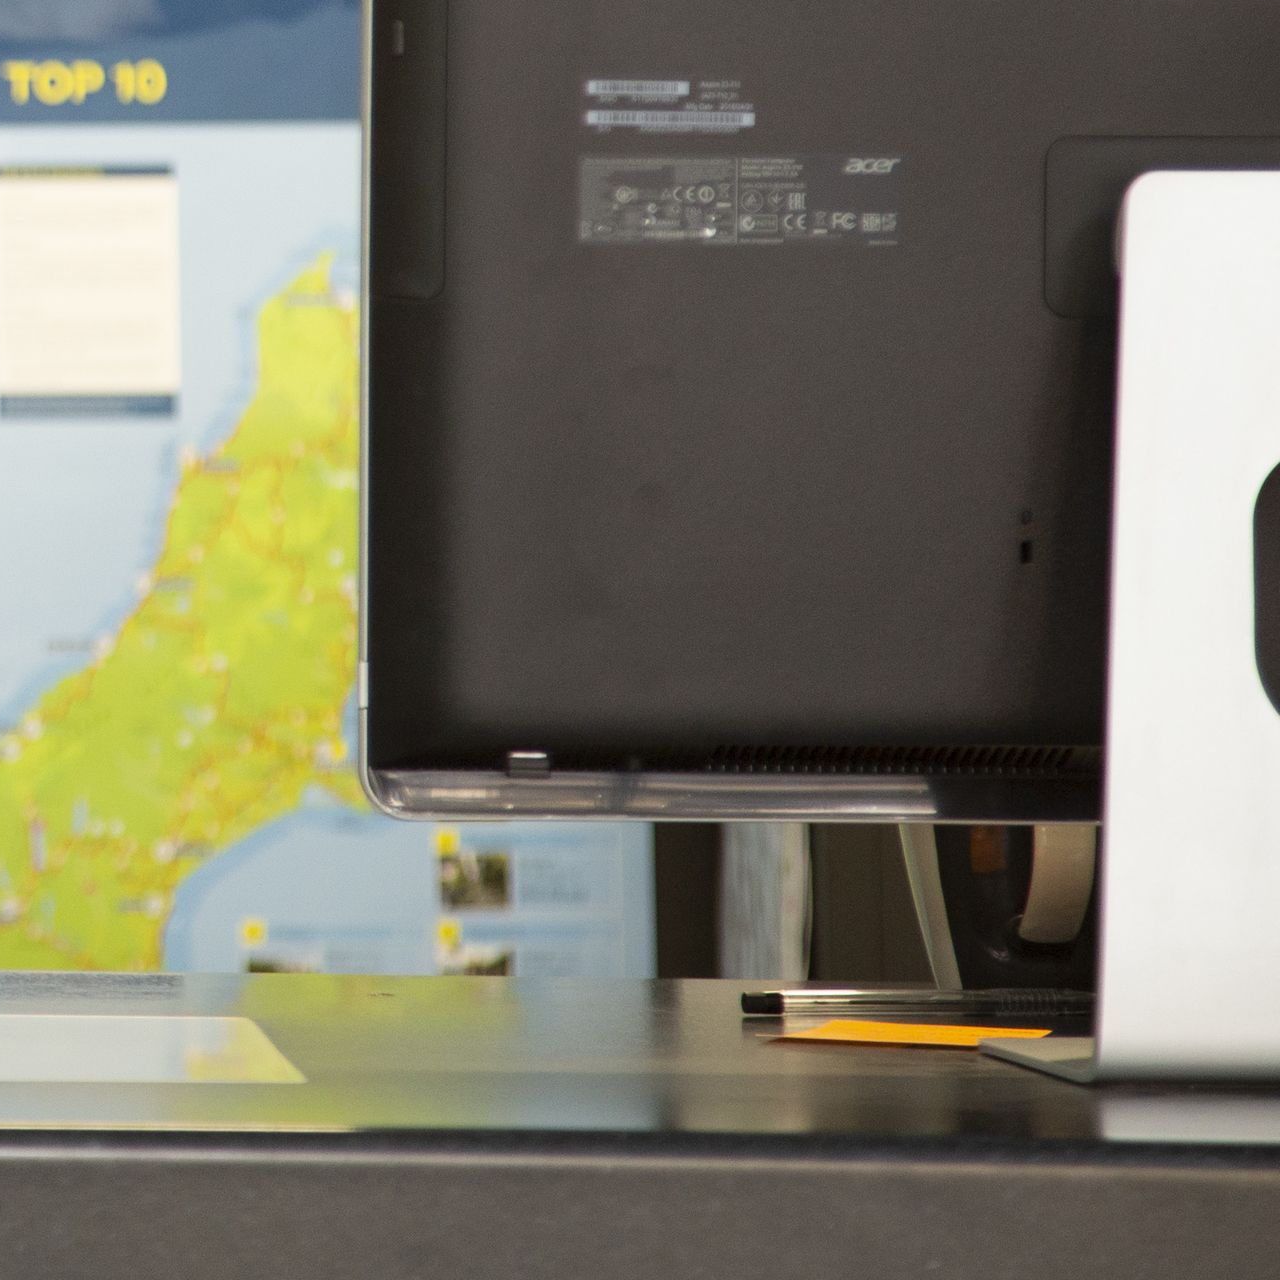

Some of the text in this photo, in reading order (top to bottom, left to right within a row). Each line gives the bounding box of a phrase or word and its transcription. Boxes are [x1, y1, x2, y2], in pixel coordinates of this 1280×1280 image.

[0, 60, 105, 105] TOP
[111, 59, 168, 105] 10
[844, 157, 901, 174] acer
